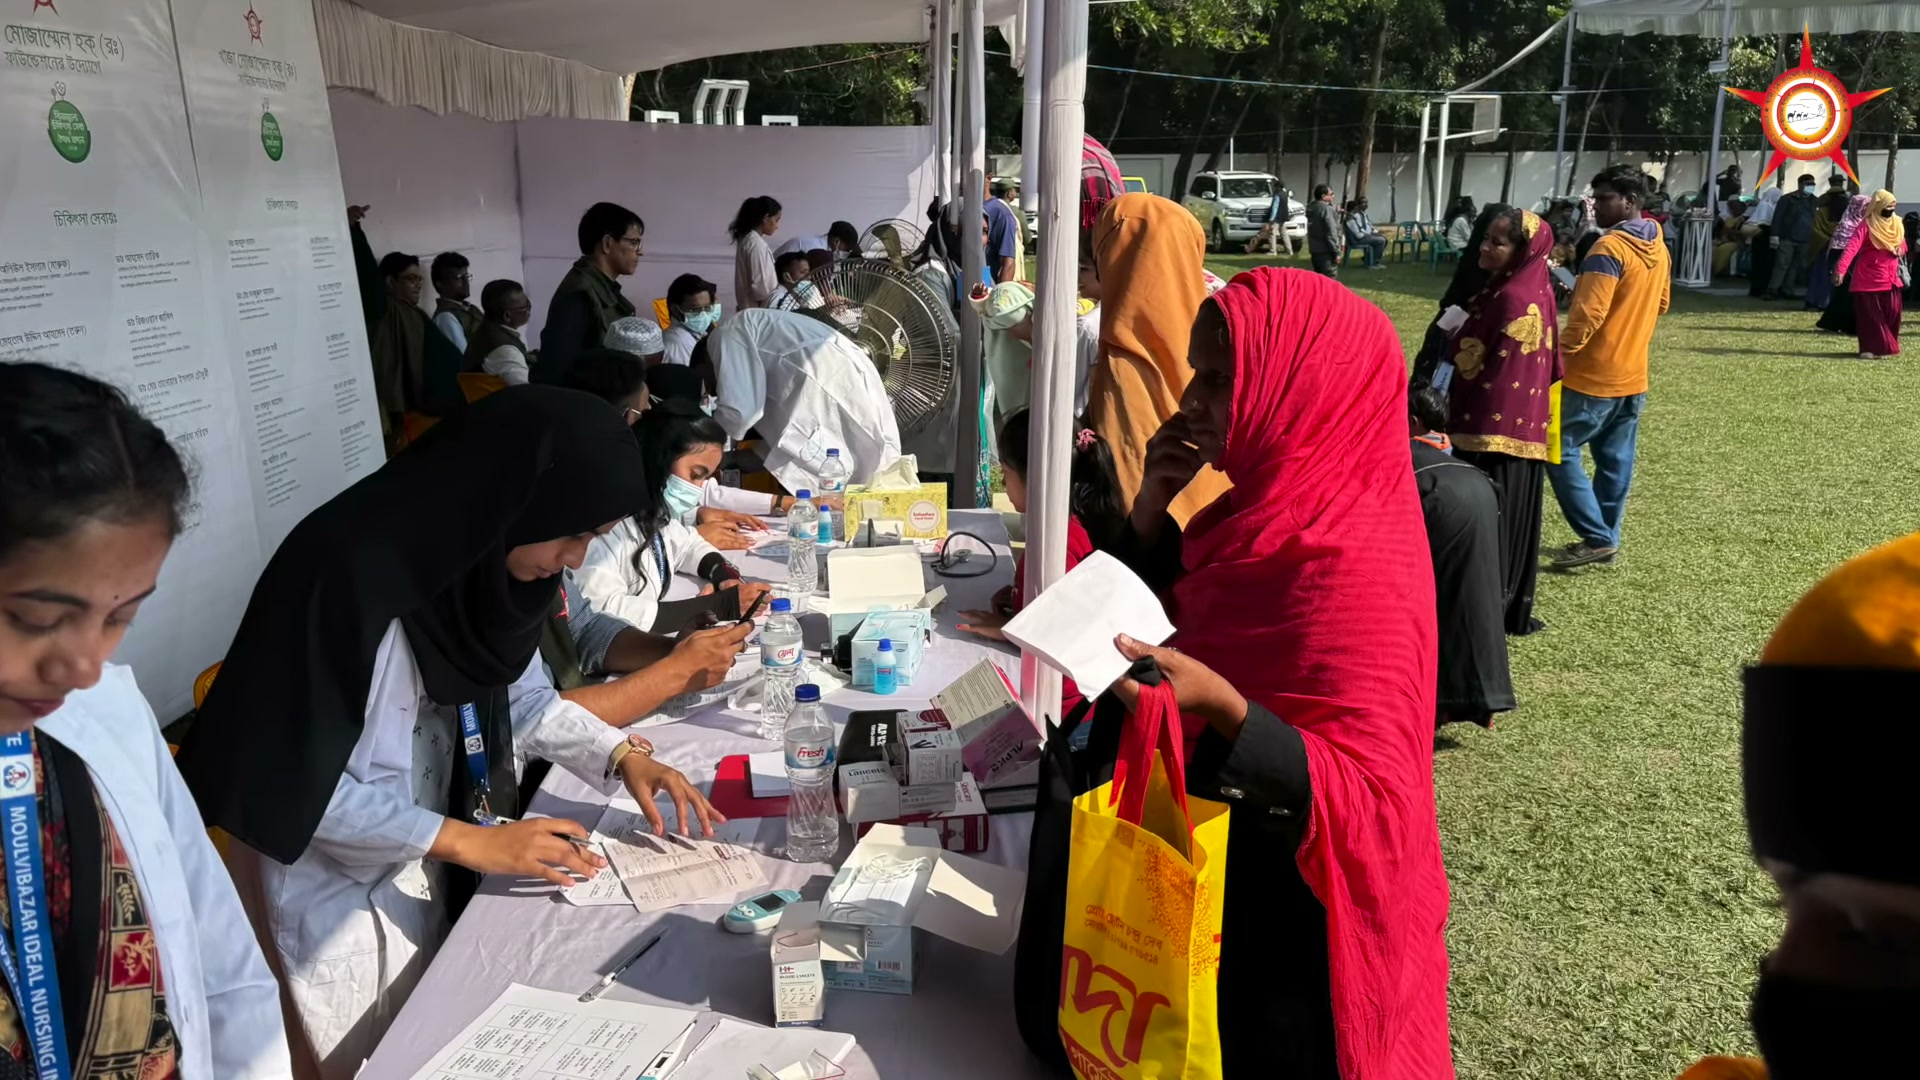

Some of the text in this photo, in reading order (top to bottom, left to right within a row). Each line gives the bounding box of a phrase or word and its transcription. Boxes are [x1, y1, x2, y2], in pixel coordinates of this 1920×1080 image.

[4, 24, 124, 62] মোজাম্মেল হক (রঃ)
[4, 50, 65, 70] ফাউন্ডেশনের
[54, 210, 88, 227] চিকিৎসা
[797, 746, 825, 758] Fresh
[10, 806, 39, 932] MOULVIBAZAR
[23, 934, 44, 987] IDEAL
[30, 987, 56, 1067] NURSING
